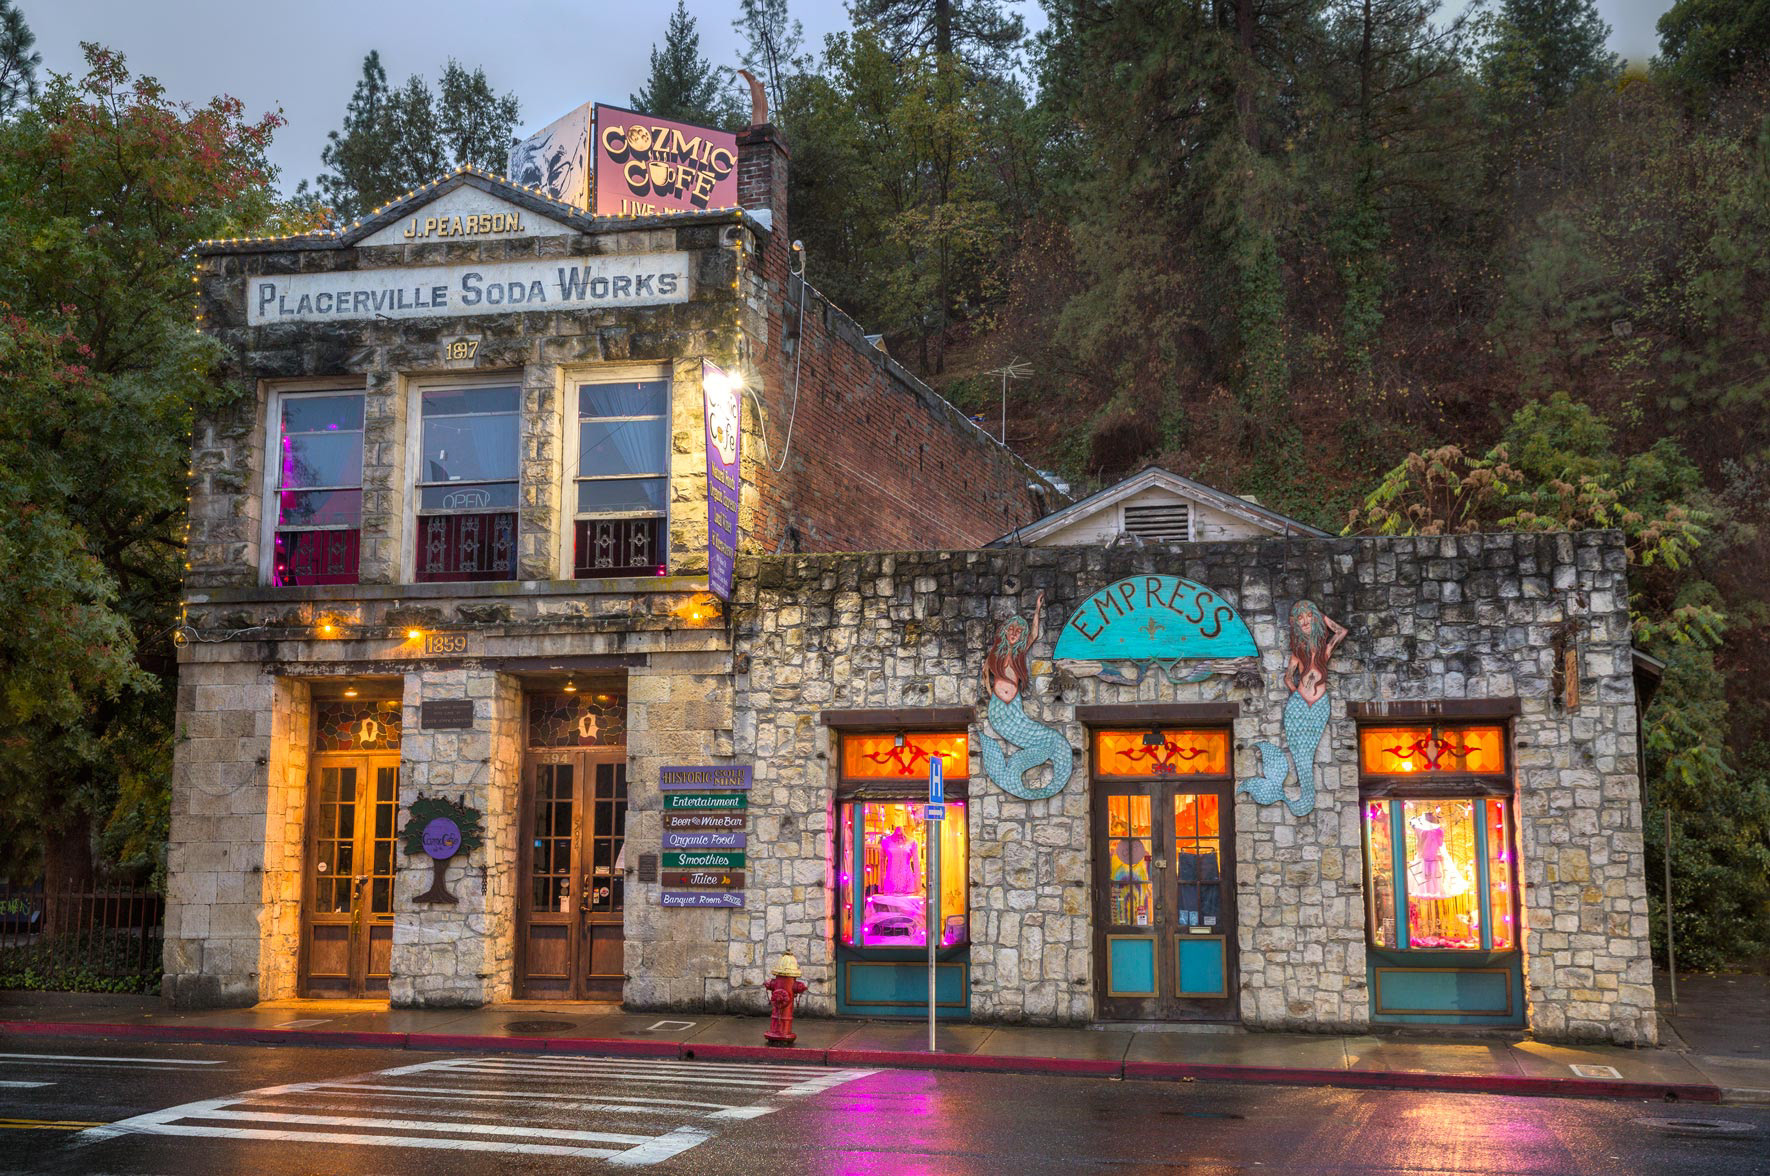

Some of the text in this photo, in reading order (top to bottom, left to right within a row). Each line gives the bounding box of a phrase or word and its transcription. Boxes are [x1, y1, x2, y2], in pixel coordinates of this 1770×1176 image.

[602, 125, 738, 176] COZMIC
[259, 266, 678, 317] PLACERVILLE SODA WORKS
[446, 342, 479, 360] 1897
[443, 493, 488, 509] OPEN
[1071, 577, 1235, 642] EMPRESS
[427, 636, 467, 653] 1859
[543, 753, 569, 764] 594
[663, 771, 713, 785] HISTORIC
[714, 769, 745, 778] GOLD
[932, 763, 941, 797] H
[714, 777, 745, 786] MINE
[672, 796, 740, 807] Entertainment
[671, 816, 692, 827] Beer
[701, 816, 725, 826] Wine
[724, 816, 743, 826] Bar
[669, 834, 736, 847] Organic Food
[678, 853, 729, 866] Smoothies
[690, 872, 718, 885] Juice
[663, 894, 696, 907] Banquet
[699, 895, 722, 904] Room
